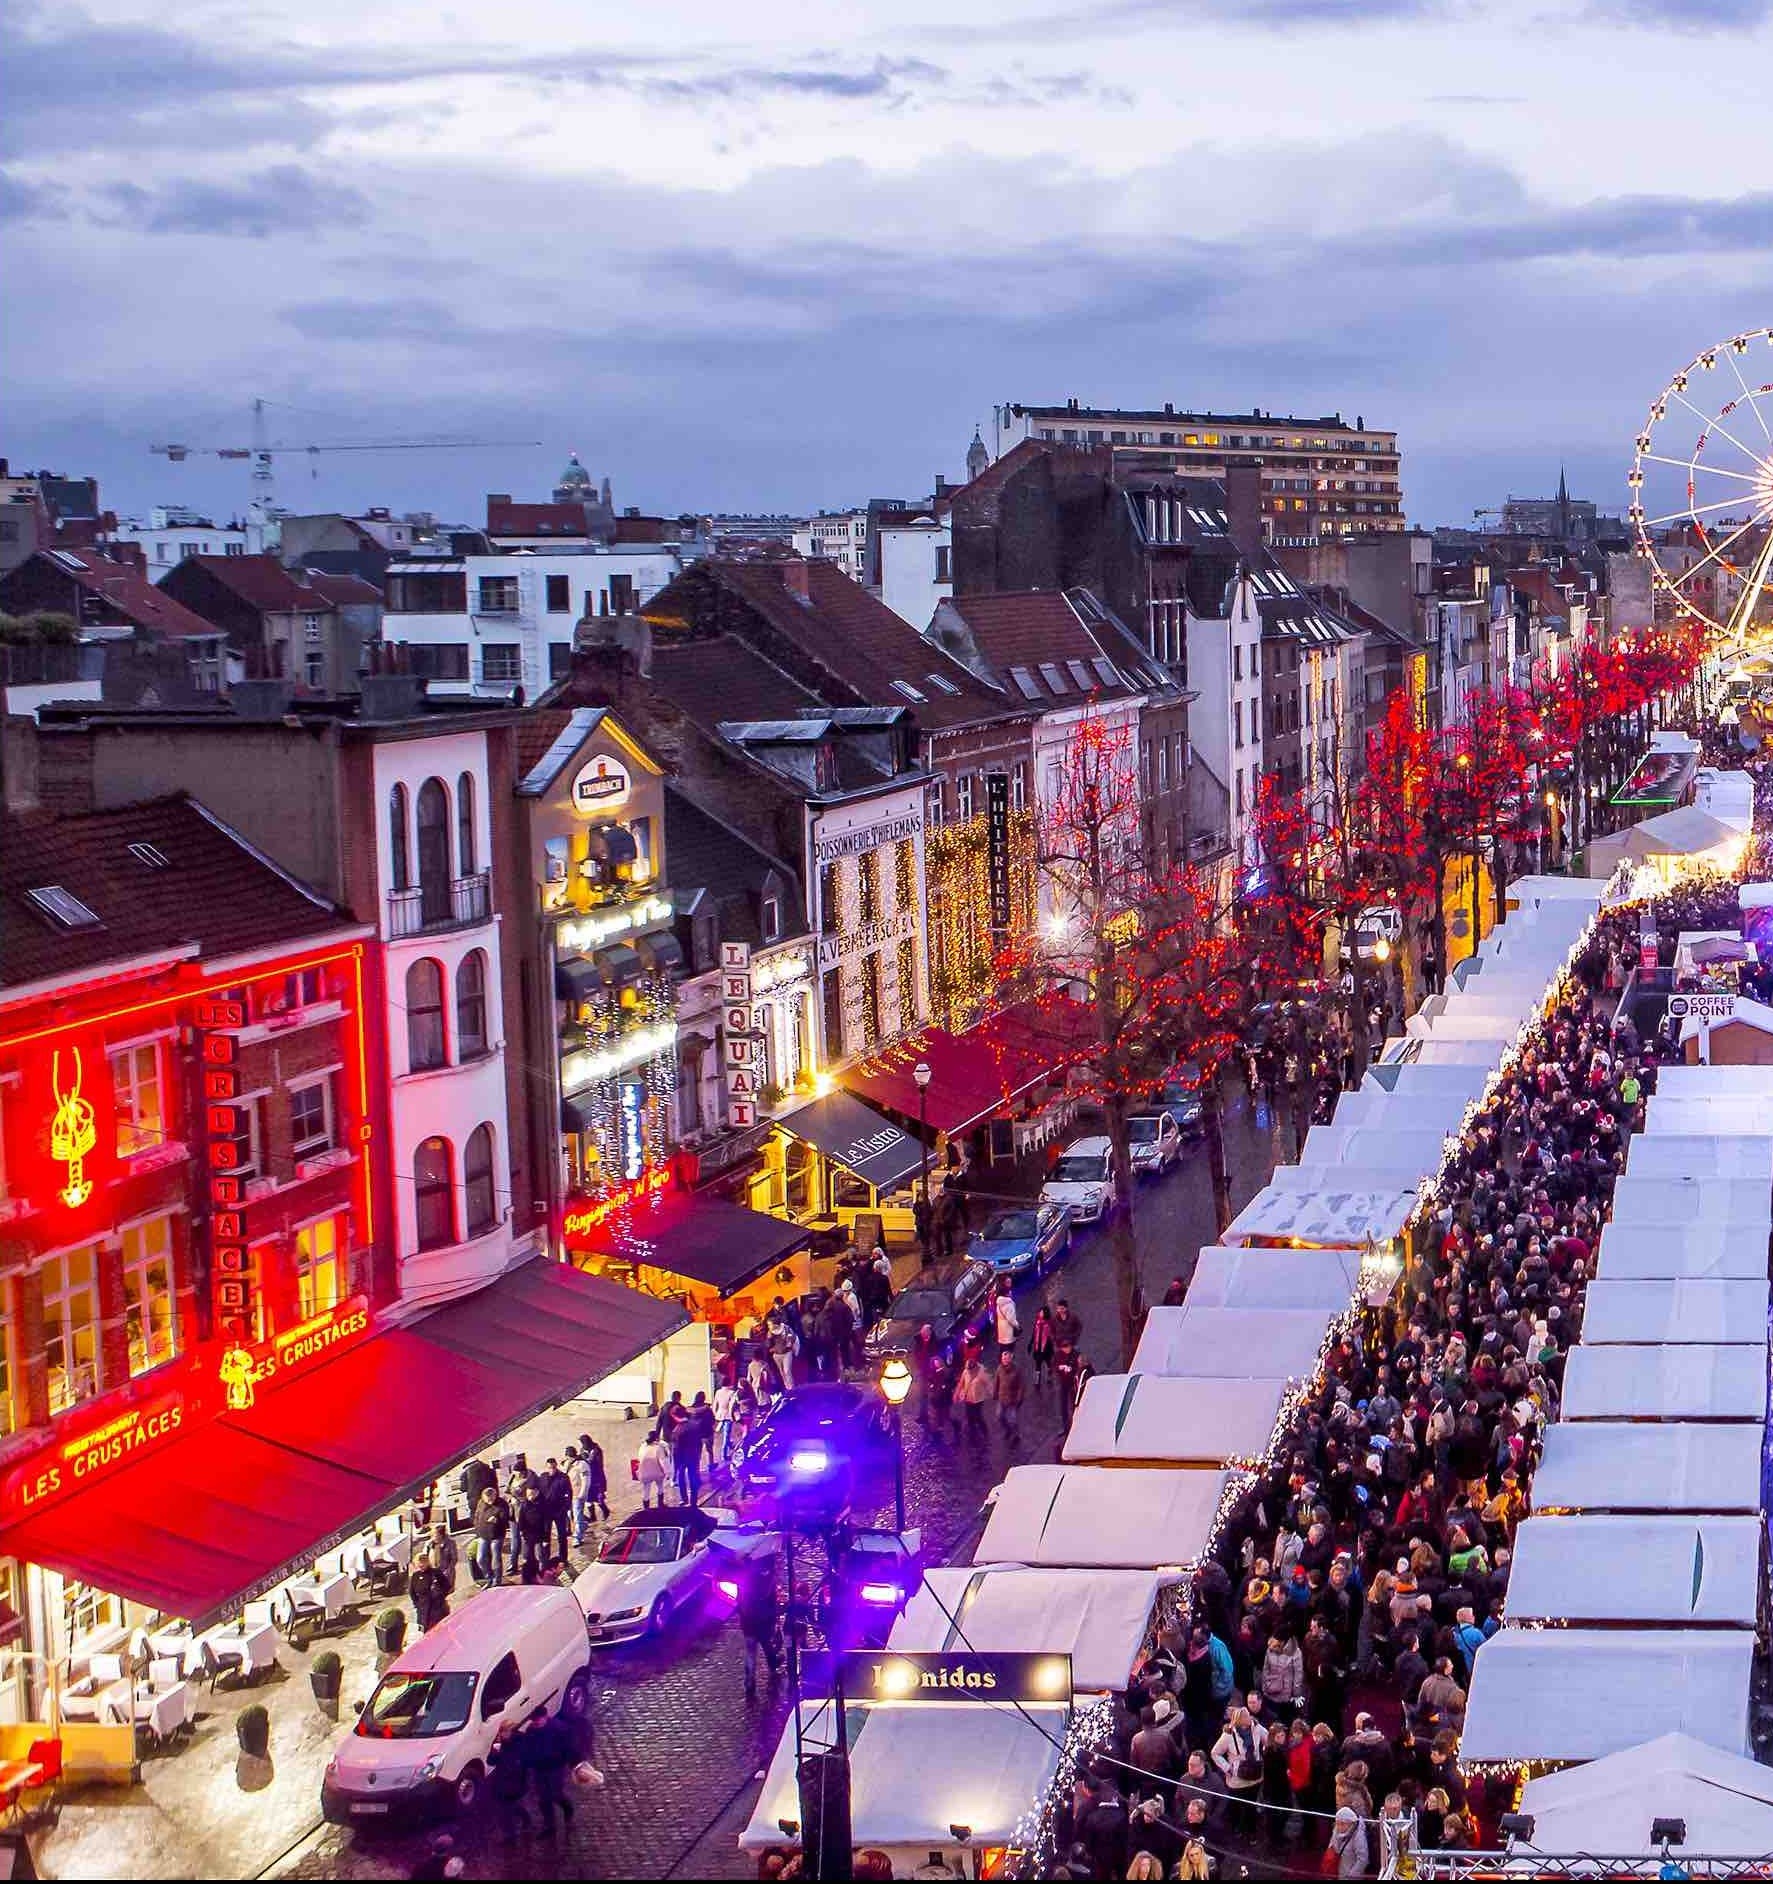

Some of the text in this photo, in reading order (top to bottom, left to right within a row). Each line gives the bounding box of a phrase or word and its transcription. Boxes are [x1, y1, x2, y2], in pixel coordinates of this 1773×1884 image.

[1690, 997, 1734, 1006] COFFEE
[1690, 1006, 1734, 1016] POINT
[833, 1127, 901, 1165] Le Vistro
[284, 1310, 367, 1366] CRUSTACES
[23, 1407, 182, 1506] LES CRUSTACES
[872, 1664, 997, 1689] Lonidas
